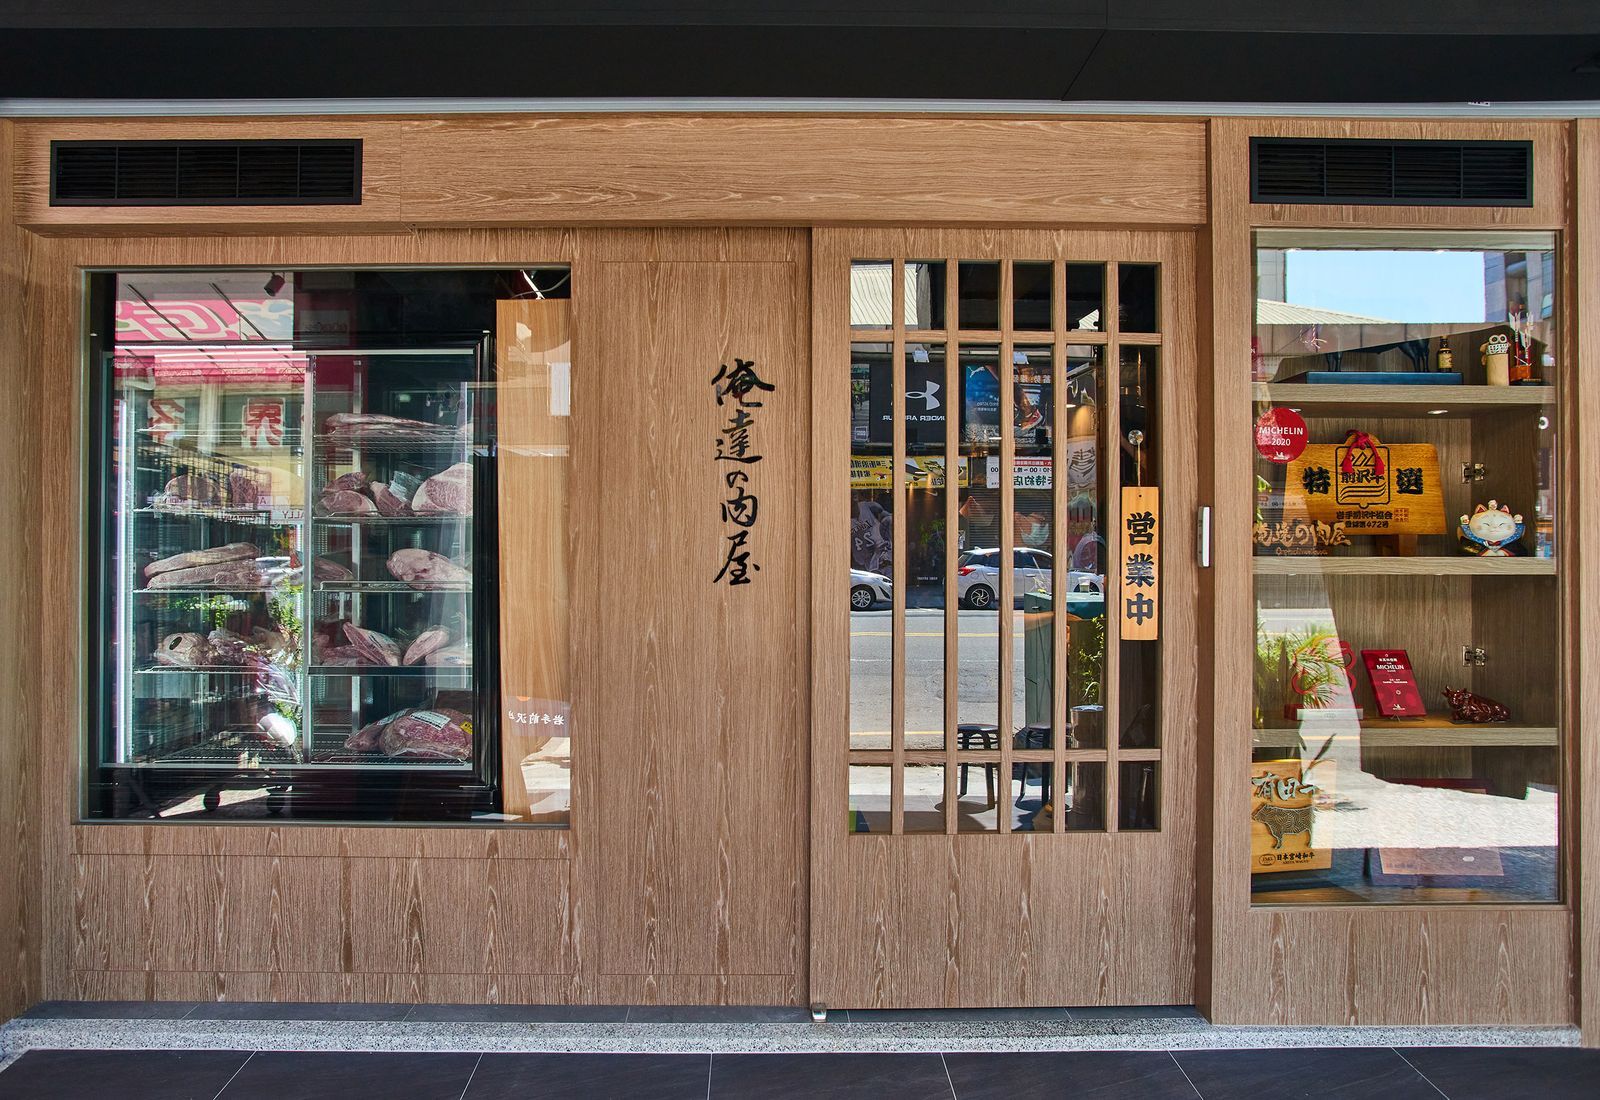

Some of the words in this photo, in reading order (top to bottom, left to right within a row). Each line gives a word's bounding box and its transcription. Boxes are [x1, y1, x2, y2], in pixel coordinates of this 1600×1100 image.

[1259, 426, 1304, 436] MICHELIN
[1271, 438, 1291, 447] 2020
[1302, 466, 1331, 494] 特
[1396, 467, 1424, 494] 選
[1126, 511, 1156, 626] 営業中
